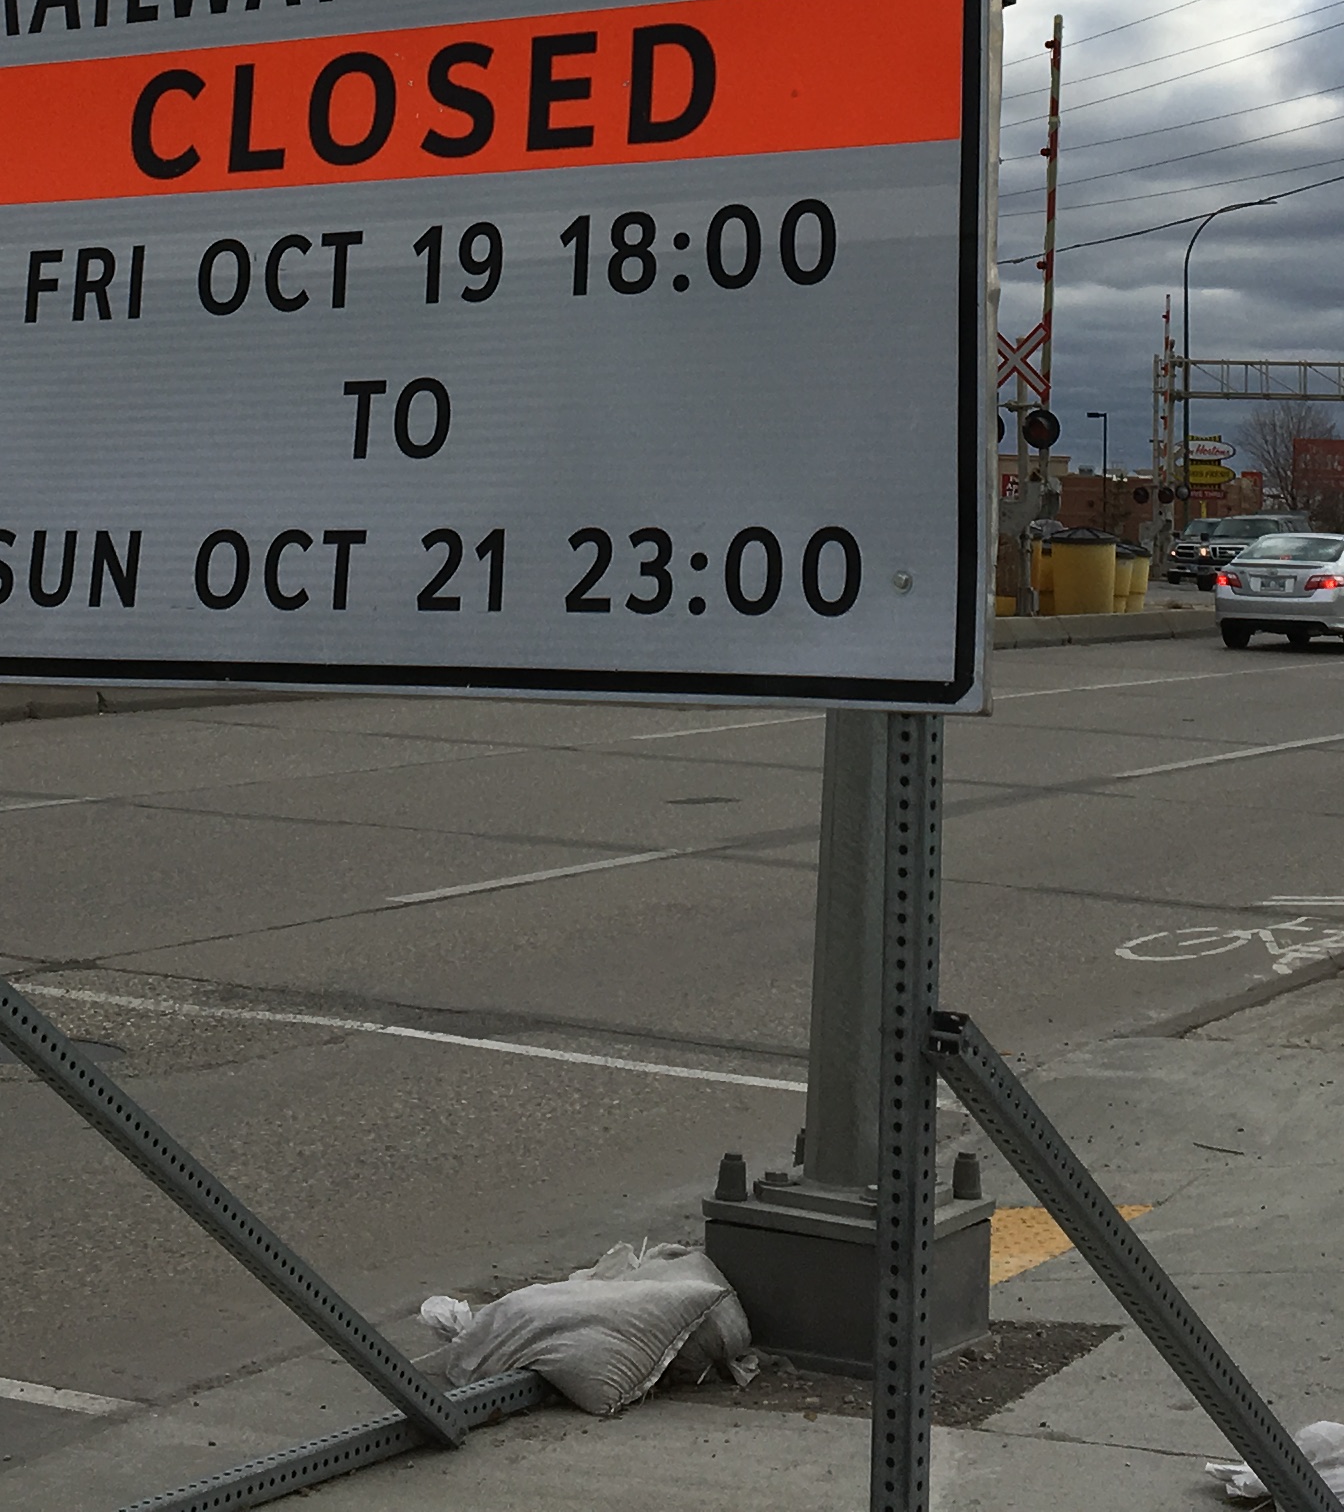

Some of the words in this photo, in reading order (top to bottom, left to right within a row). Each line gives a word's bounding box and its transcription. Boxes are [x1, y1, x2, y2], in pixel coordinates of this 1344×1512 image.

[131, 23, 717, 180] CLOSED
[24, 244, 146, 324] FRI
[197, 230, 364, 317] OCT
[412, 221, 504, 305] 19
[559, 198, 838, 297] 18:00
[343, 376, 452, 460] TO
[194, 528, 368, 612] OCT
[416, 527, 506, 613] 21
[564, 525, 862, 618] 23:00
